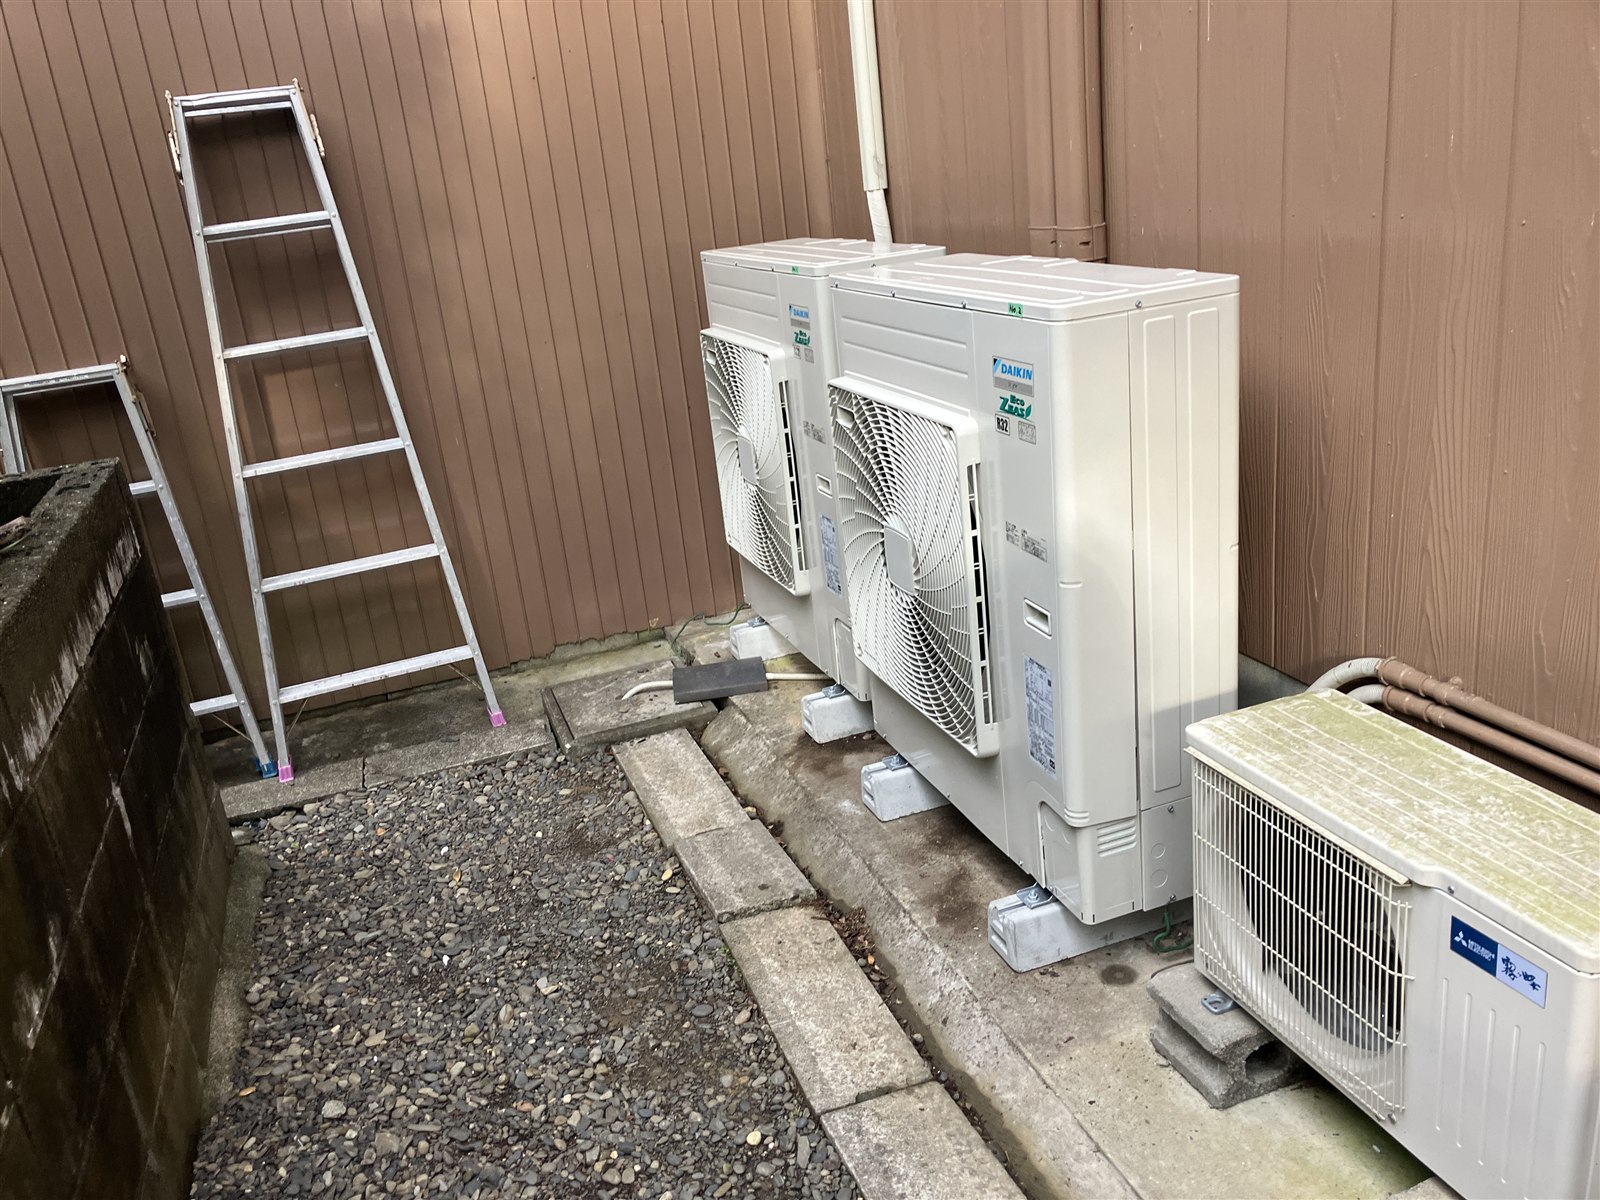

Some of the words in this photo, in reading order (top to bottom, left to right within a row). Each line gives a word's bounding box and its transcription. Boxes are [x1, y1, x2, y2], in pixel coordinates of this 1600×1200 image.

[1001, 363, 1033, 380] DAIKIN
[999, 396, 1025, 417] ZEAS
[996, 417, 1009, 433] R32
